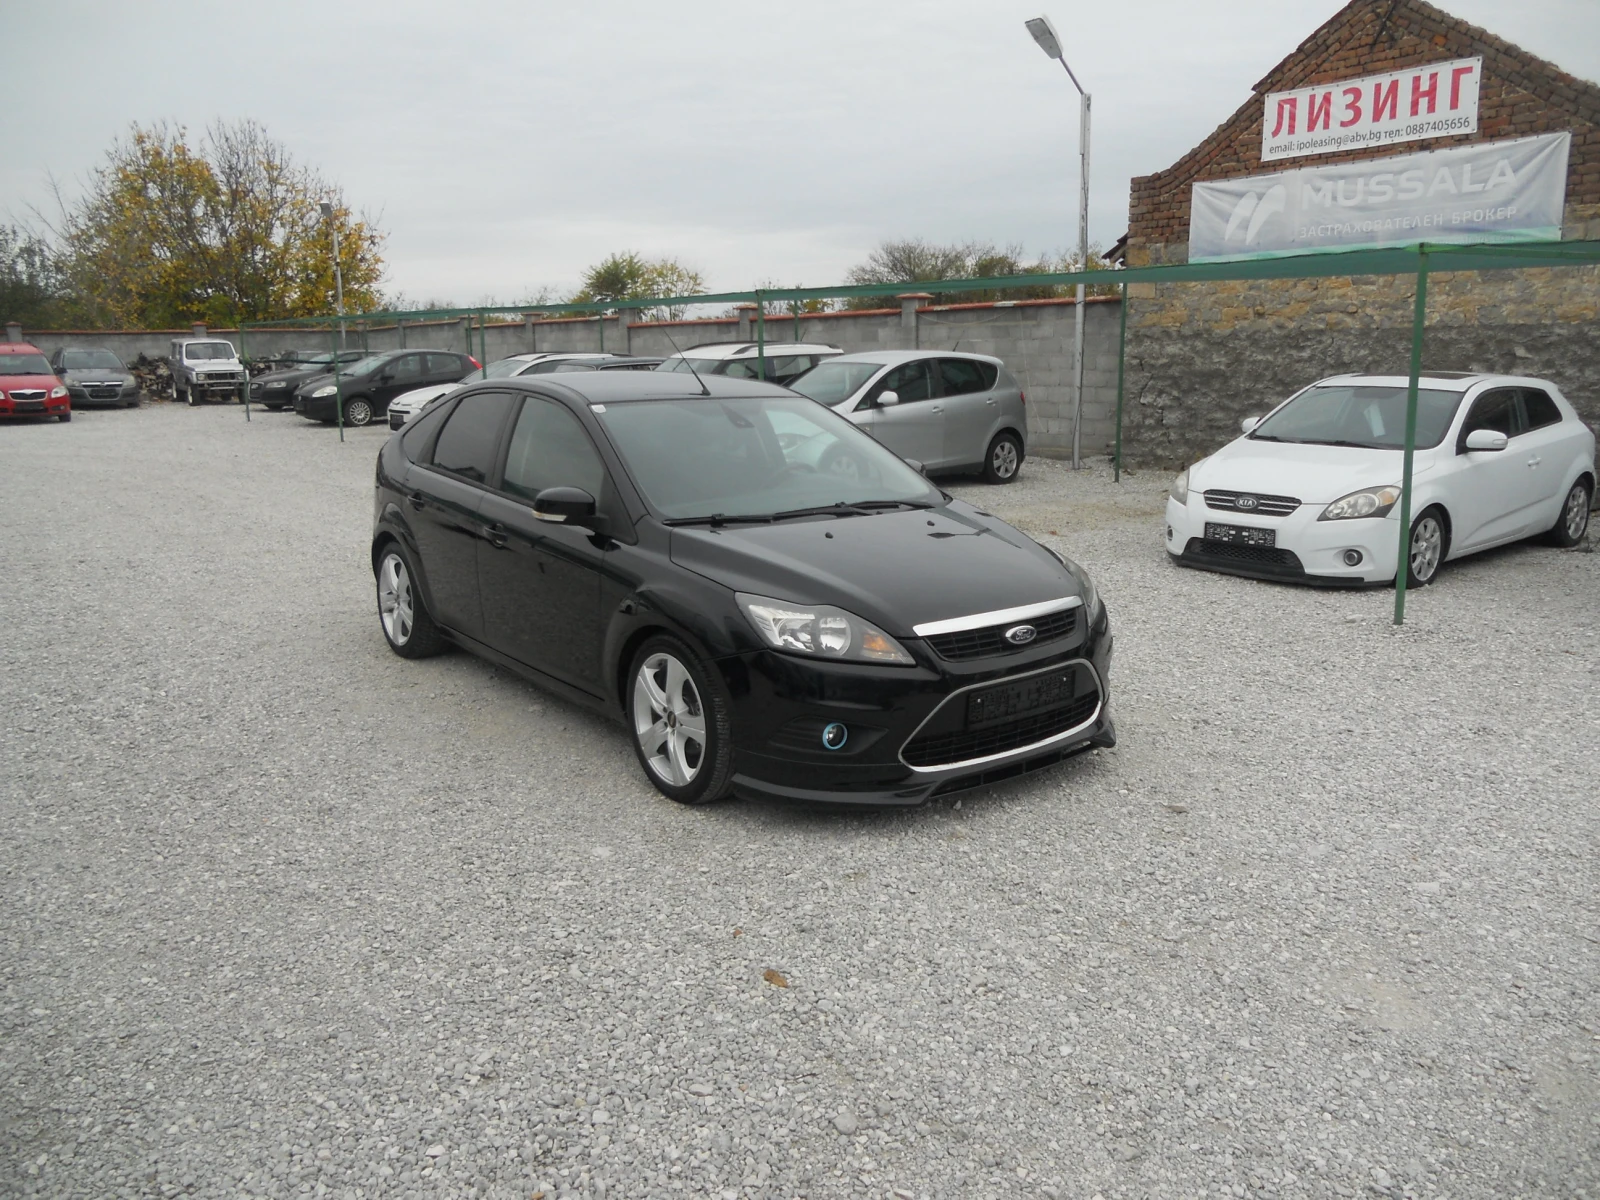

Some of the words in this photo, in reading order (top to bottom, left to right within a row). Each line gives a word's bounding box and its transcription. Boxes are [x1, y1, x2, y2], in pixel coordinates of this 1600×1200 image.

[1271, 66, 1474, 138] ЛИЗИНГ
[1269, 142, 1295, 154] email:
[1296, 130, 1382, 151] ipoleasing@abv.bg
[1383, 128, 1404, 140] тел:
[1405, 117, 1470, 136] 0887405656
[1301, 158, 1518, 210] MUSSALA
[1300, 213, 1443, 238] ЗАСТРАХОВАТЕЛЕН
[1451, 206, 1517, 224] БРОКЕР
[1015, 629, 1031, 640] Ford
